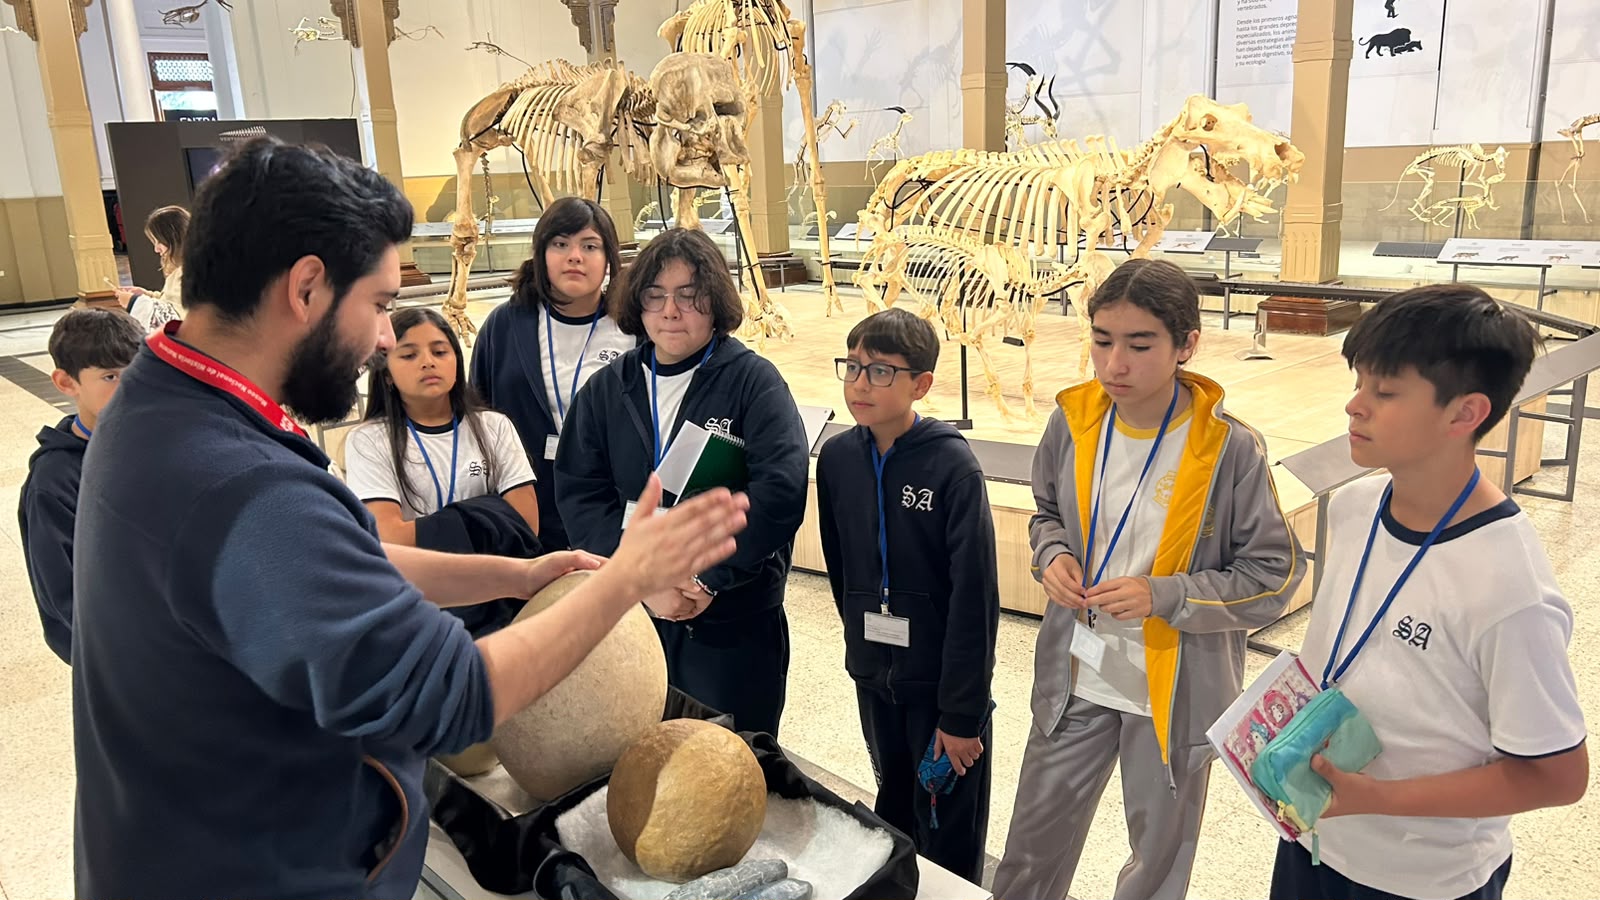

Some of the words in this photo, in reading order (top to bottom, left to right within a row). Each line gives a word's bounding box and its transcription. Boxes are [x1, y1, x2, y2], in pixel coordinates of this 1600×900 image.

[1261, 16, 1283, 24] primeros
[178, 354, 206, 371] Historia
[206, 366, 216, 375] de
[216, 371, 247, 392] Nacional
[246, 388, 268, 407] Museo
[902, 484, 934, 512] SA
[1392, 615, 1432, 650] SA
